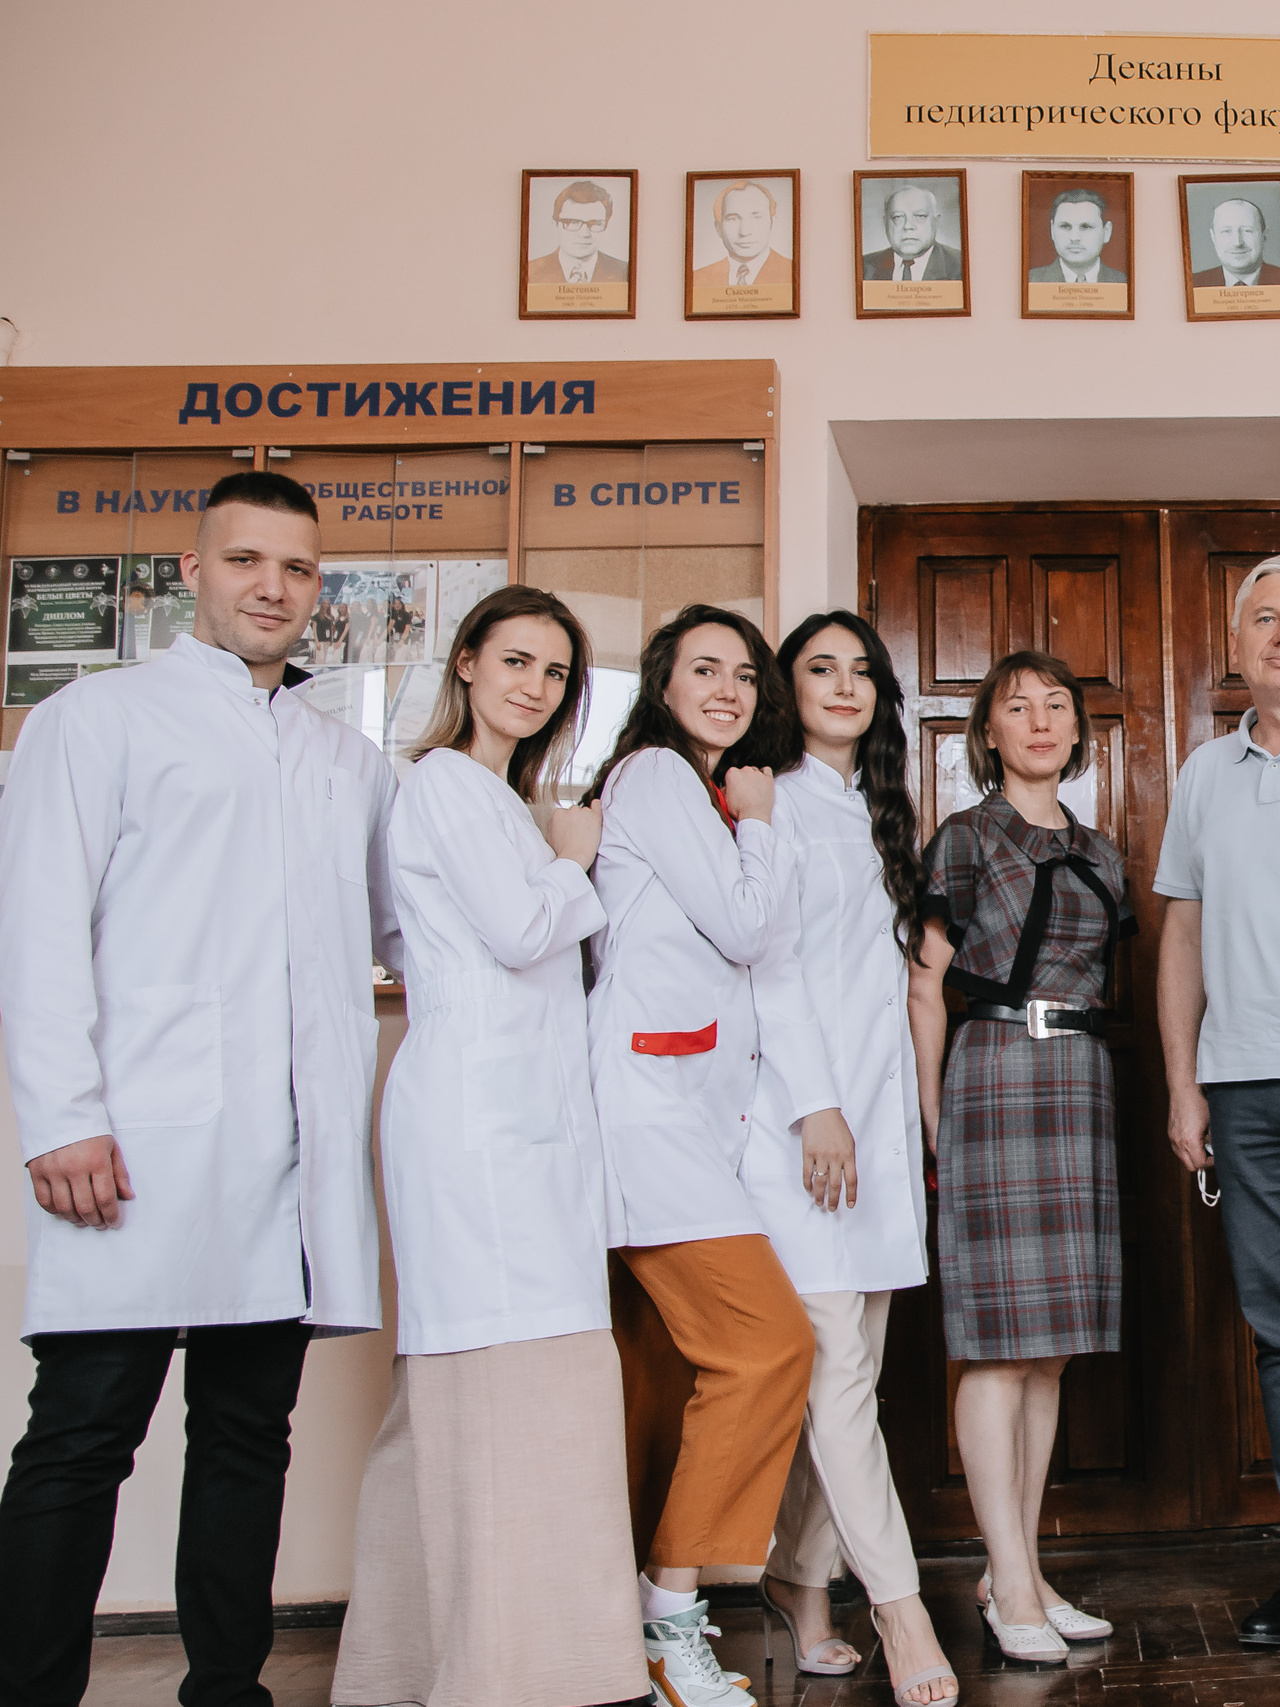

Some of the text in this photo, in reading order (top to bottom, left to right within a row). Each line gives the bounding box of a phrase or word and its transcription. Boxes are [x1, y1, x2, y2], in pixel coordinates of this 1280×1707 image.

[1088, 52, 1223, 86] Деканы
[905, 101, 1202, 133] педиатрического
[725, 287, 759, 296] Сысоев
[896, 284, 932, 294] Назаров
[1058, 286, 1098, 295] Борисков
[180, 381, 596, 425] ДОСТИЖЕНИЯ
[58, 492, 81, 514] В
[555, 482, 741, 506] В СПОРТЕ
[344, 504, 443, 522] РАБОТЕ
[36, 591, 93, 601] БЕЛЫЕ ЦВЕТЫ
[42, 611, 85, 621] ДИПЛОМ
